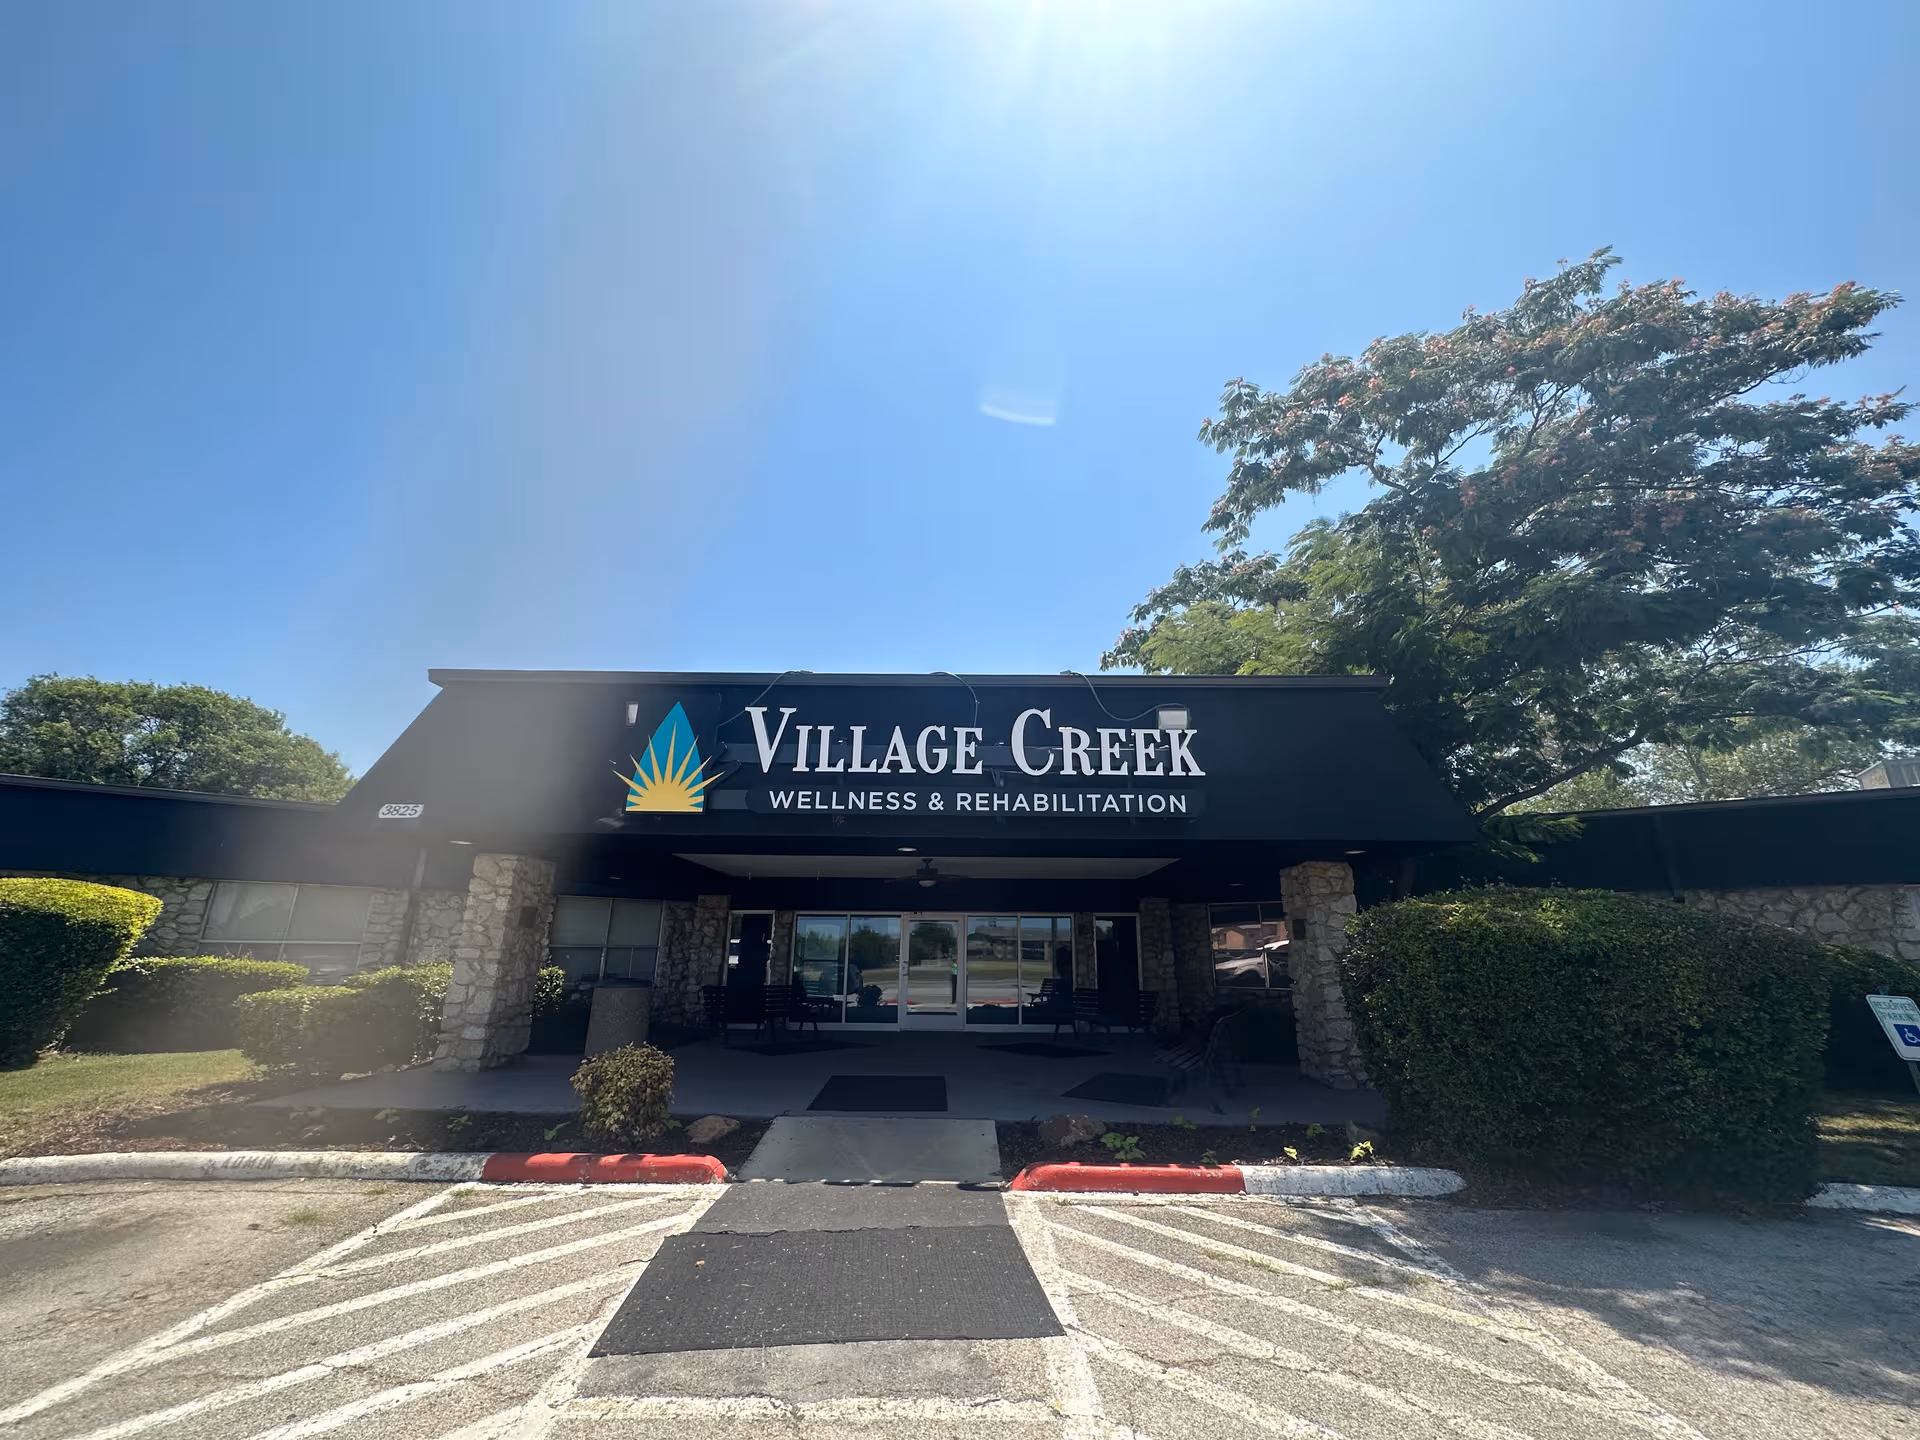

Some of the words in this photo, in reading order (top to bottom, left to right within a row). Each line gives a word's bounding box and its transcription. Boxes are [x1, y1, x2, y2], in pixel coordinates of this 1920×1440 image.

[744, 706, 983, 775] VILLAGE
[1010, 708, 1206, 777] CREEK
[382, 805, 419, 816] 3825
[769, 790, 917, 812] WELLNESS
[929, 792, 945, 812] &
[956, 792, 1187, 814] REHABILITATION
[1872, 1001, 1915, 1011] RESERVED
